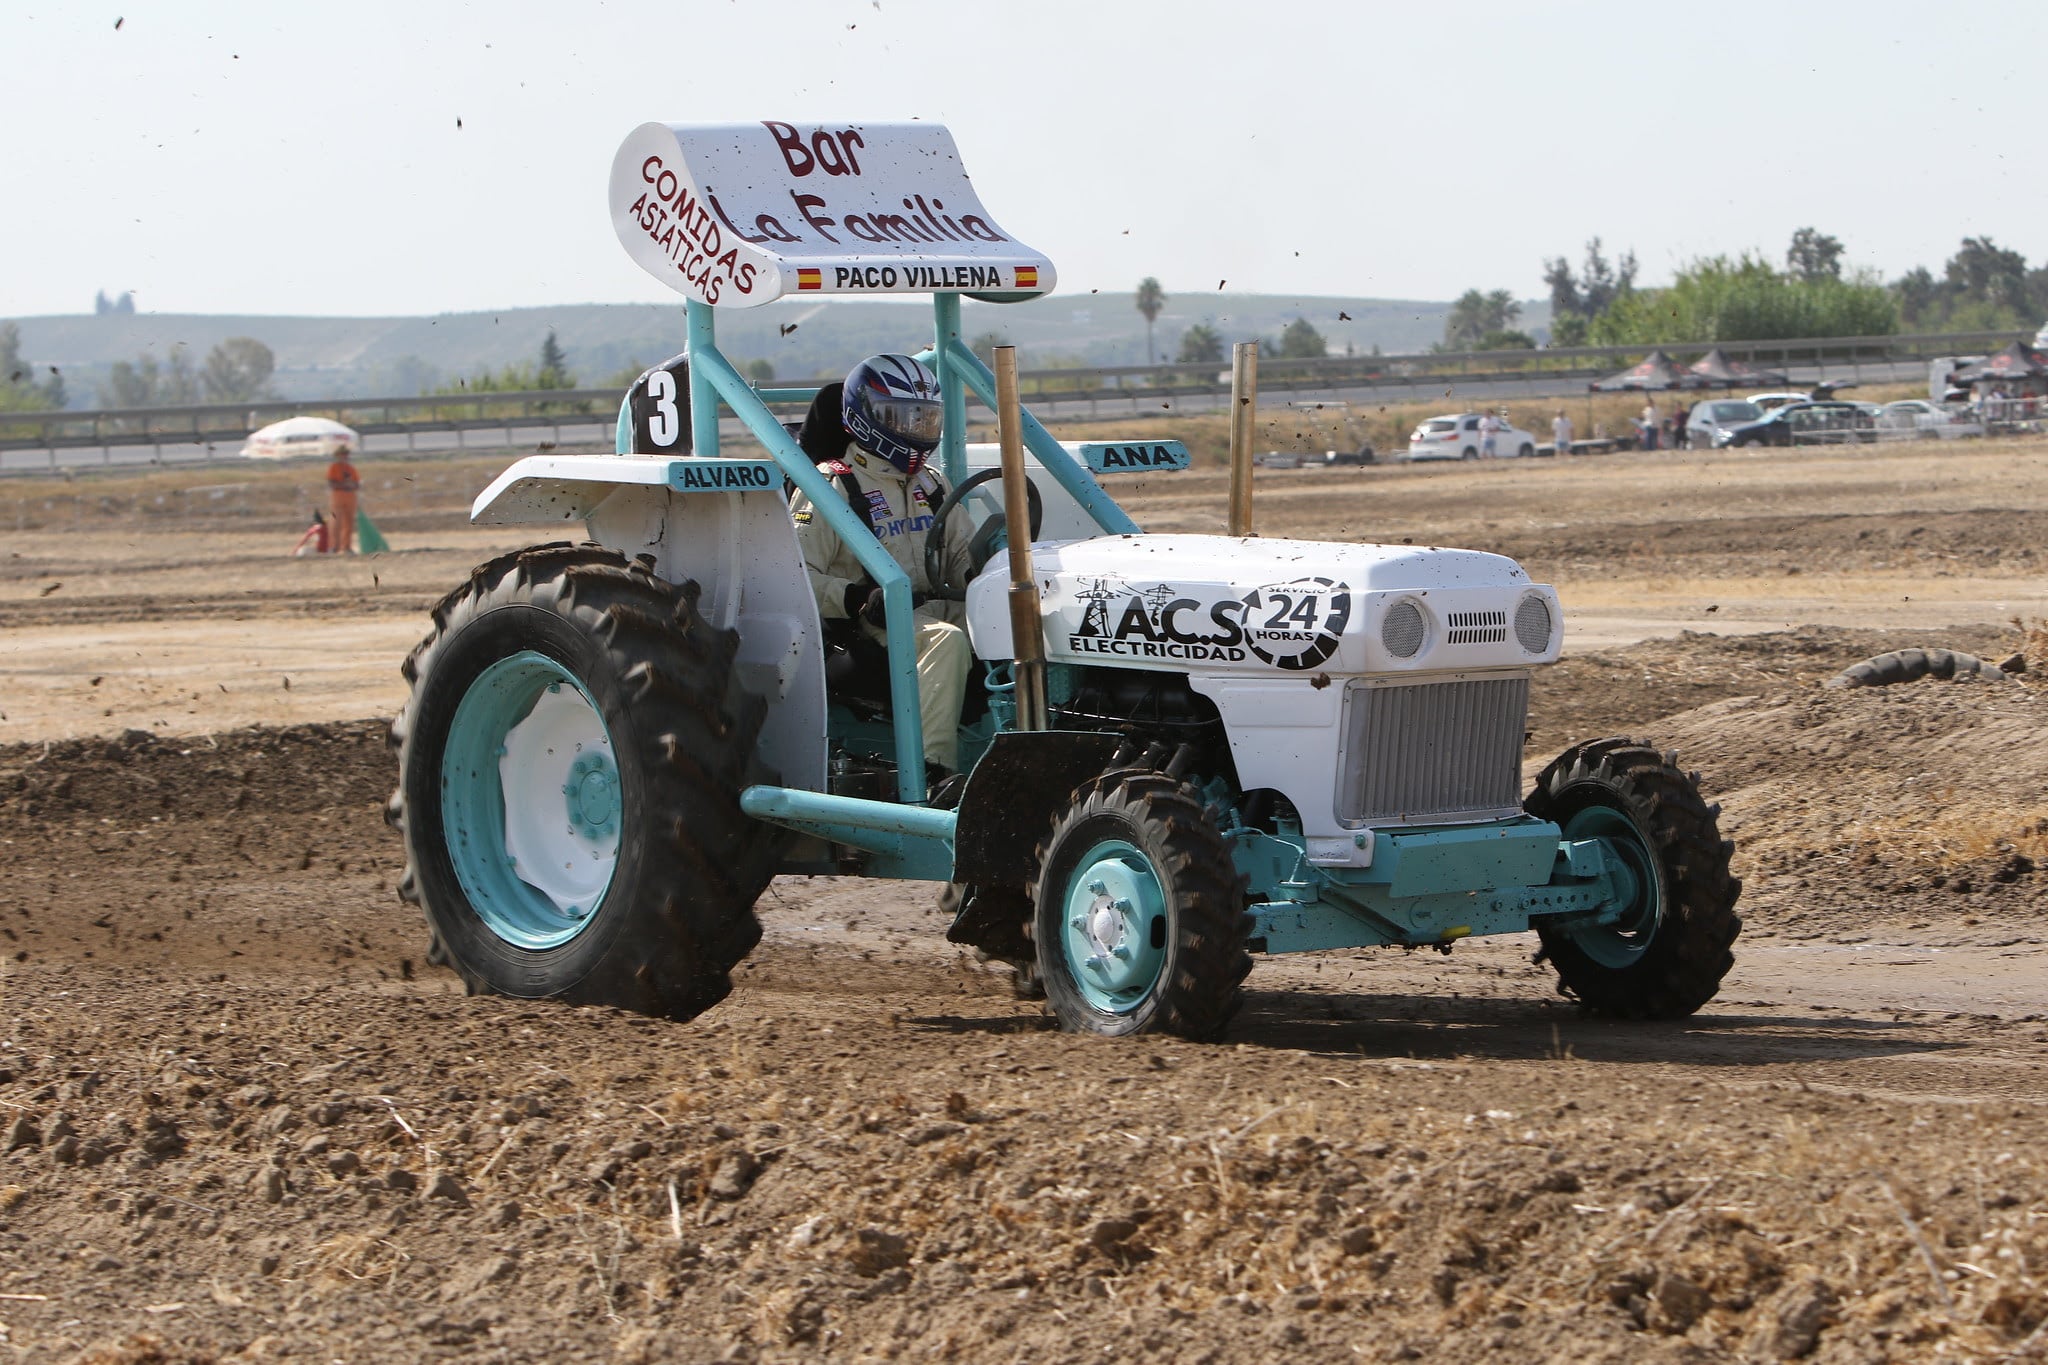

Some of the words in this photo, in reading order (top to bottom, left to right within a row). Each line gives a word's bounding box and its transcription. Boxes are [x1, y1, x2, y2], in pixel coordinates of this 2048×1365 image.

[760, 120, 864, 177] Bar
[642, 155, 757, 294] COMIDAS
[708, 194, 802, 243] La
[793, 194, 1009, 244] Familia
[629, 192, 723, 305] ASIATICAS
[835, 266, 897, 288] PACO
[903, 265, 1001, 288] VILLENA
[647, 370, 679, 447] 3
[1103, 445, 1178, 468] ANA
[684, 465, 770, 488] ALVARO
[1264, 593, 1319, 630] 24
[1070, 637, 1246, 662] ELECTRICIDAD
[1256, 630, 1315, 642] HORAS
